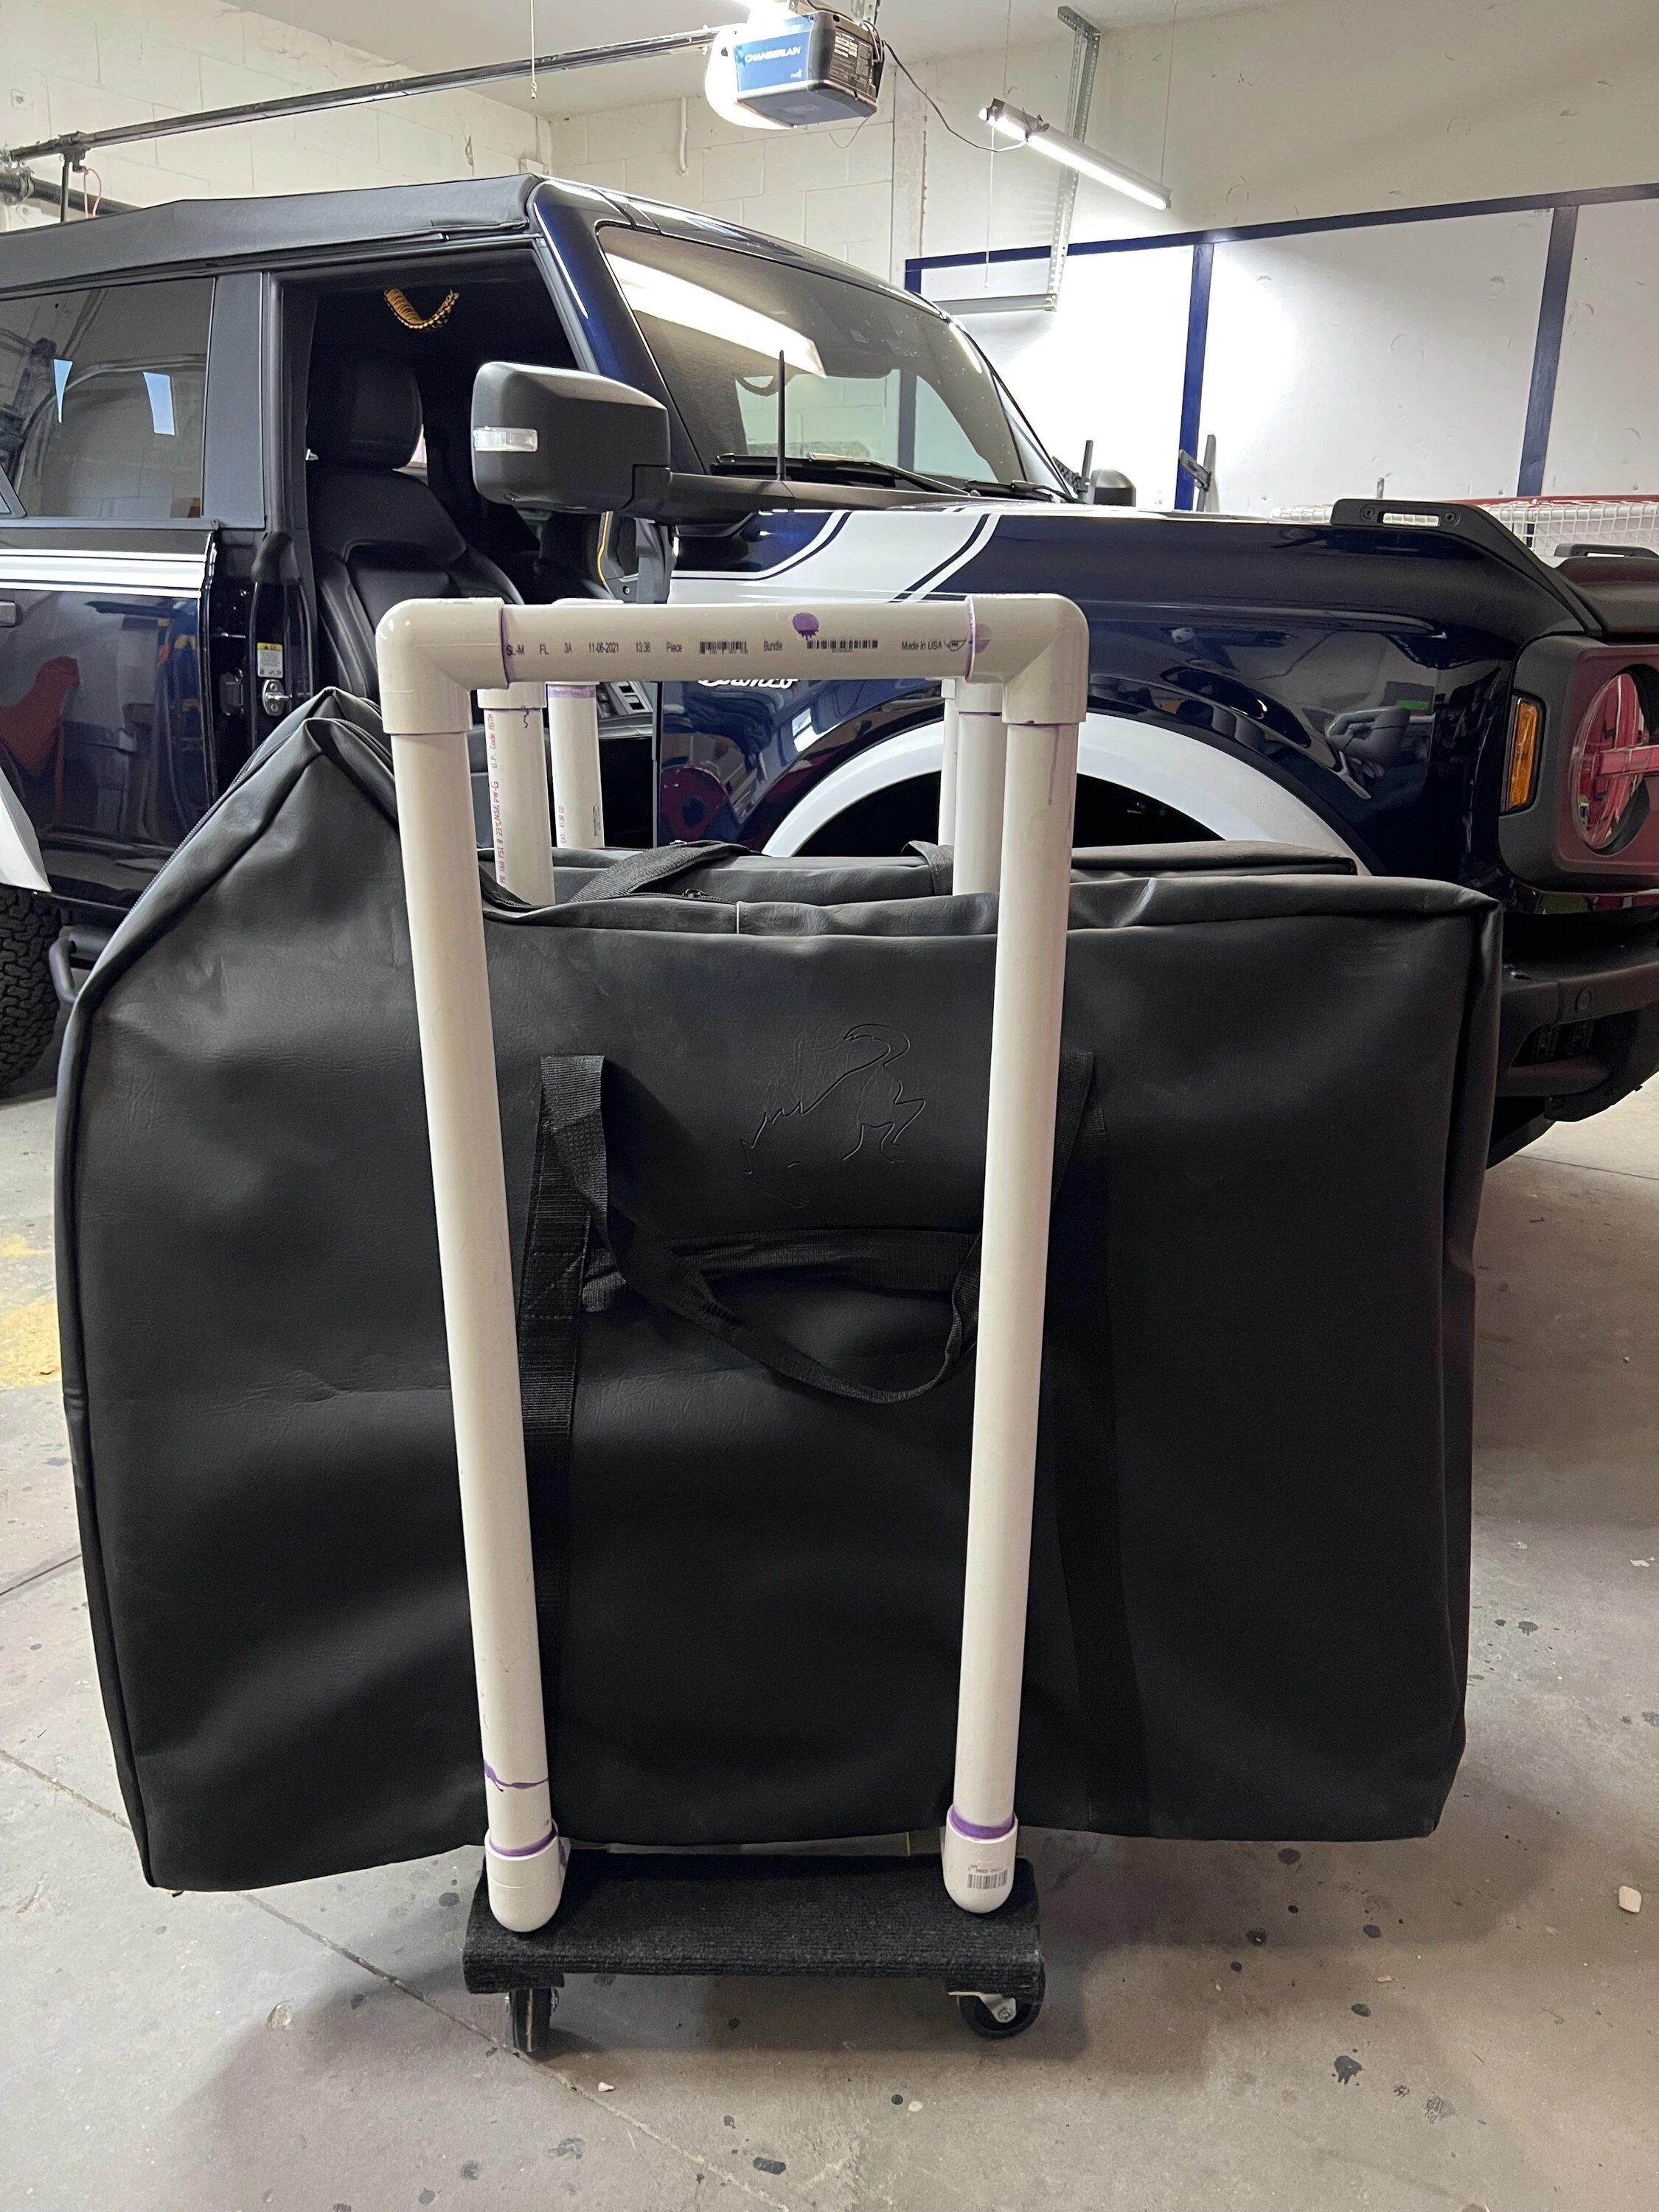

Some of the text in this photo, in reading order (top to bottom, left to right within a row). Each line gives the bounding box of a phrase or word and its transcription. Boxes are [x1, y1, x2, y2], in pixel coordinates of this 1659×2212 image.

[540, 644, 549, 655] FL
[667, 641, 683, 653] Piece
[763, 639, 783, 652] Bundle
[901, 640, 919, 650] Made
[920, 640, 926, 650] in
[928, 640, 942, 650] USA
